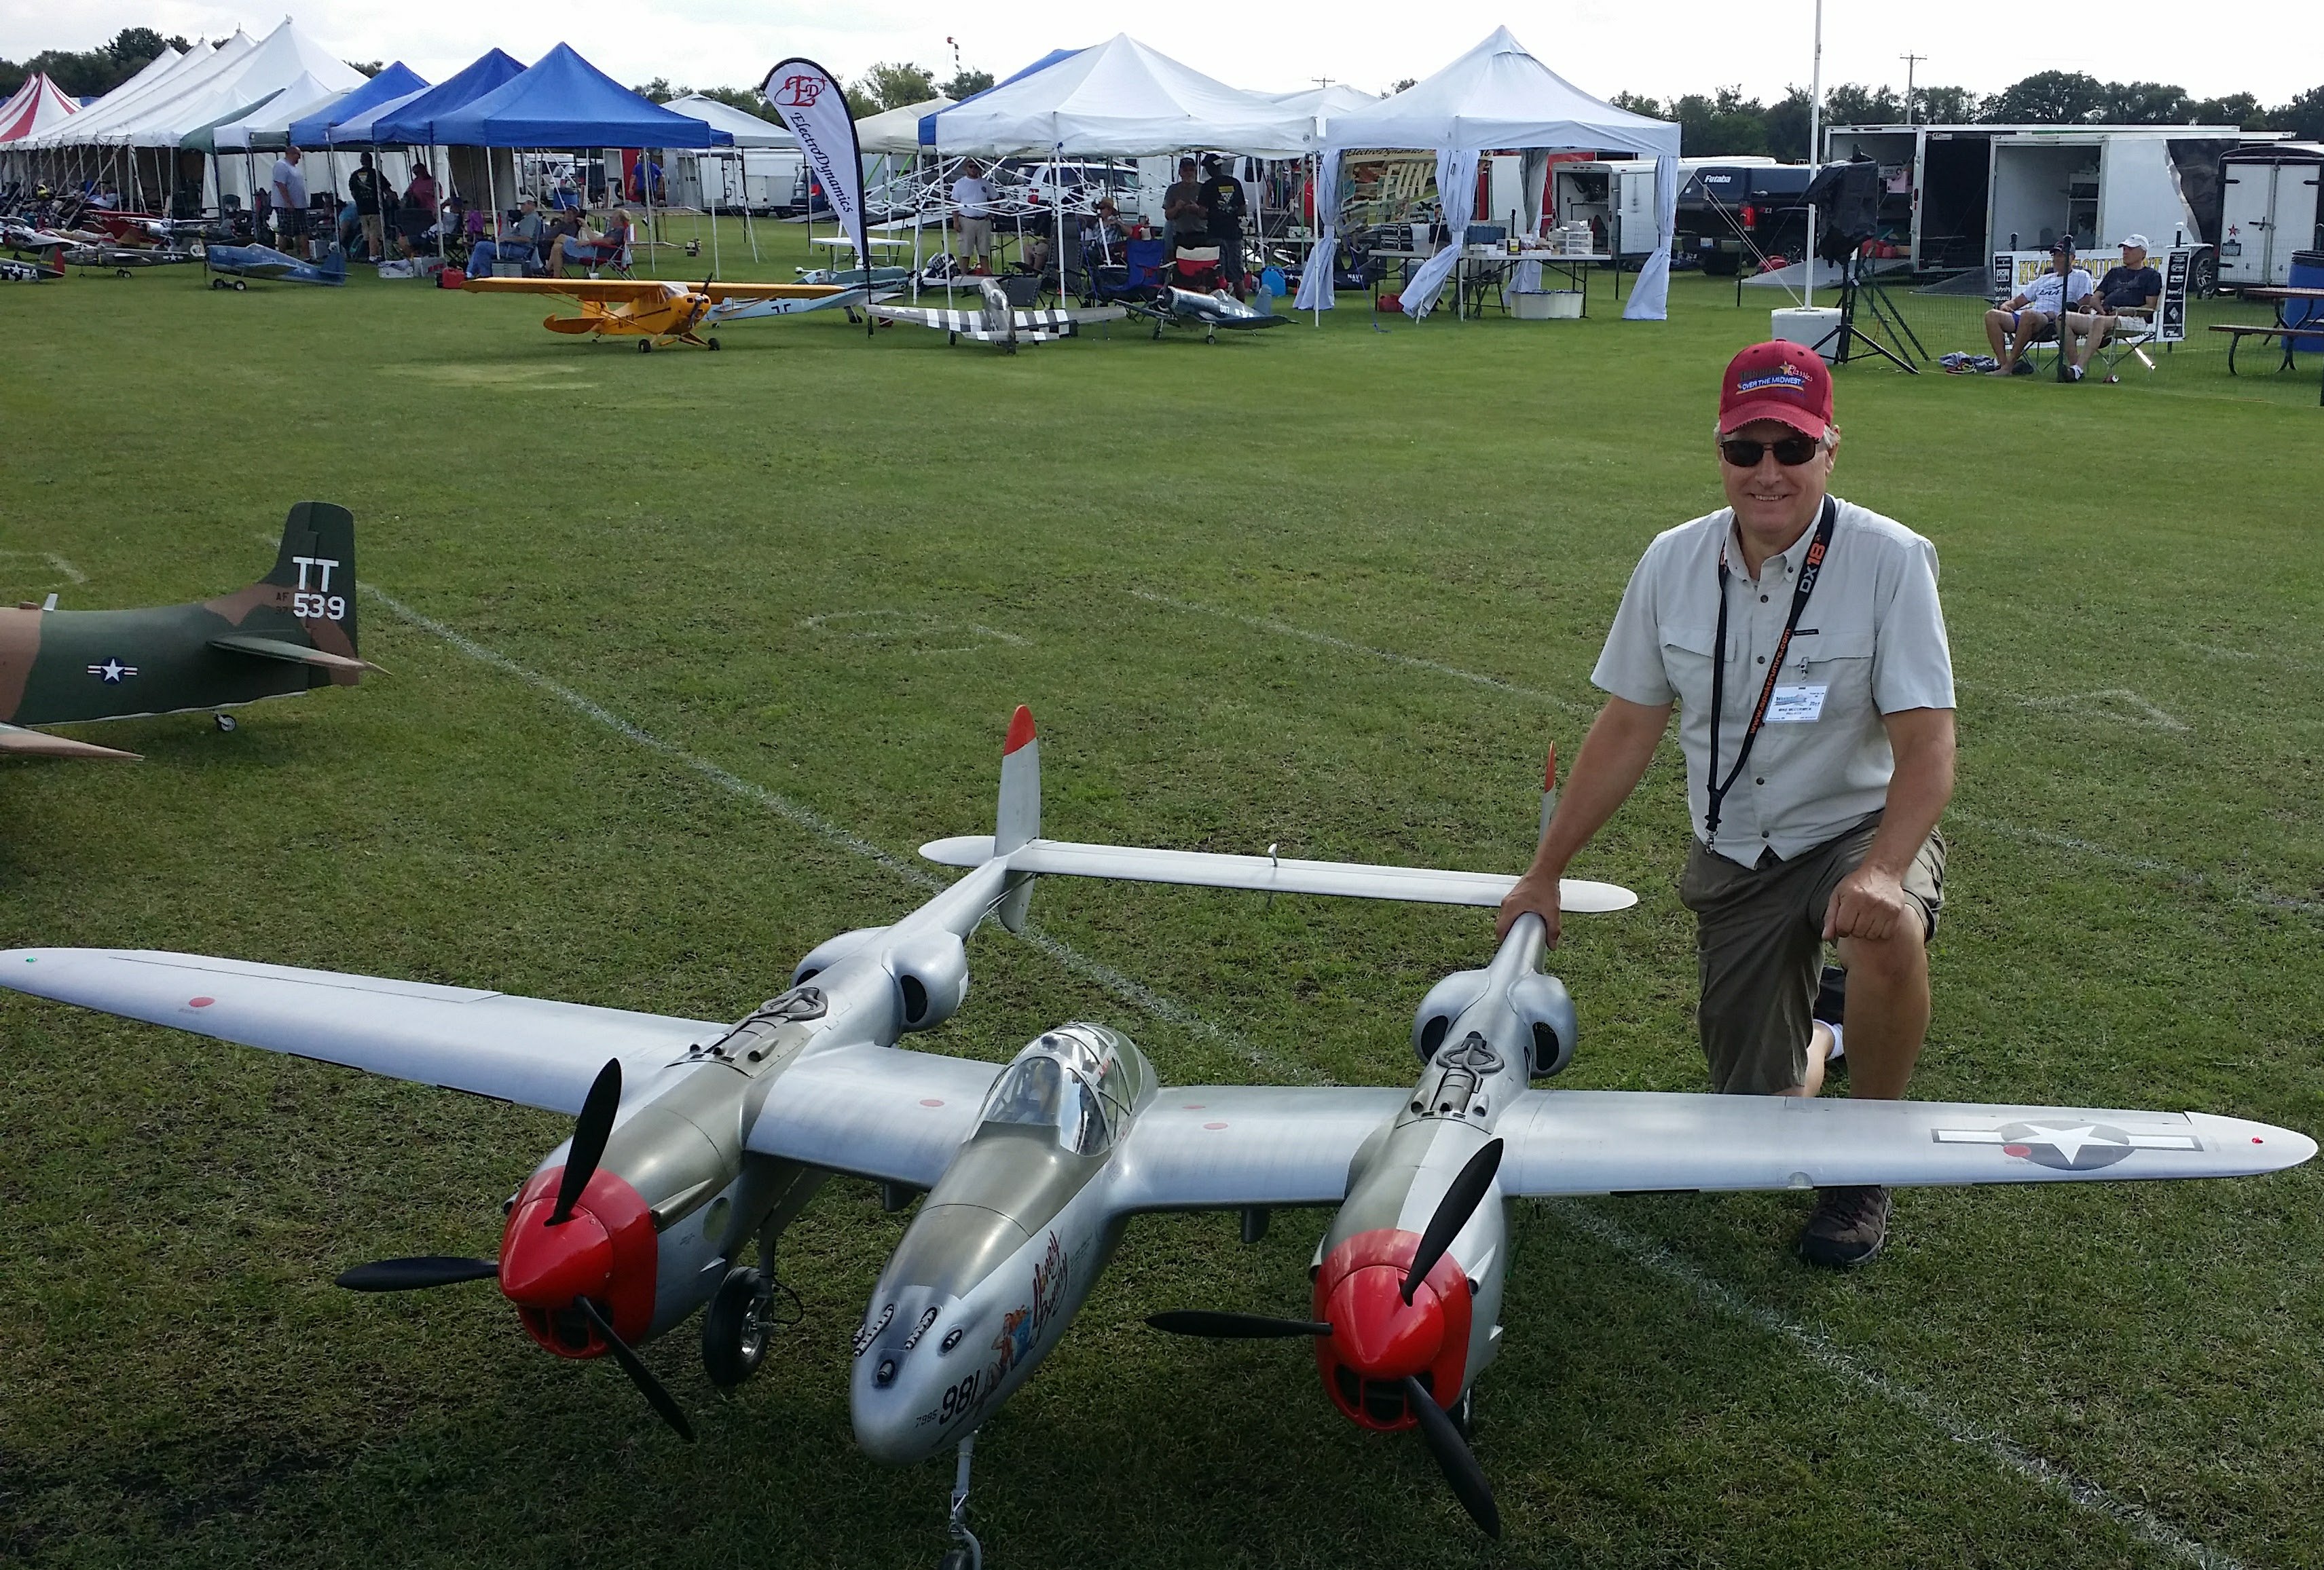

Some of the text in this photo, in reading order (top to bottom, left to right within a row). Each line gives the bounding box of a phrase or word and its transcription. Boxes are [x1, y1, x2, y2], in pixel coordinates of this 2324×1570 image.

[790, 112, 853, 213] ElectroDynamics
[1704, 174, 1732, 183] Futaba
[1382, 162, 1435, 201] FUN
[1742, 376, 1801, 390] OVER THE MIDWEST
[1788, 365, 1813, 382] Classics
[293, 557, 339, 593] TT
[1799, 542, 1826, 593] DX18
[276, 592, 289, 601] AF
[293, 593, 346, 620] 539
[1750, 628, 1791, 734] www.spektrumrc.com
[940, 1369, 980, 1425] 981
